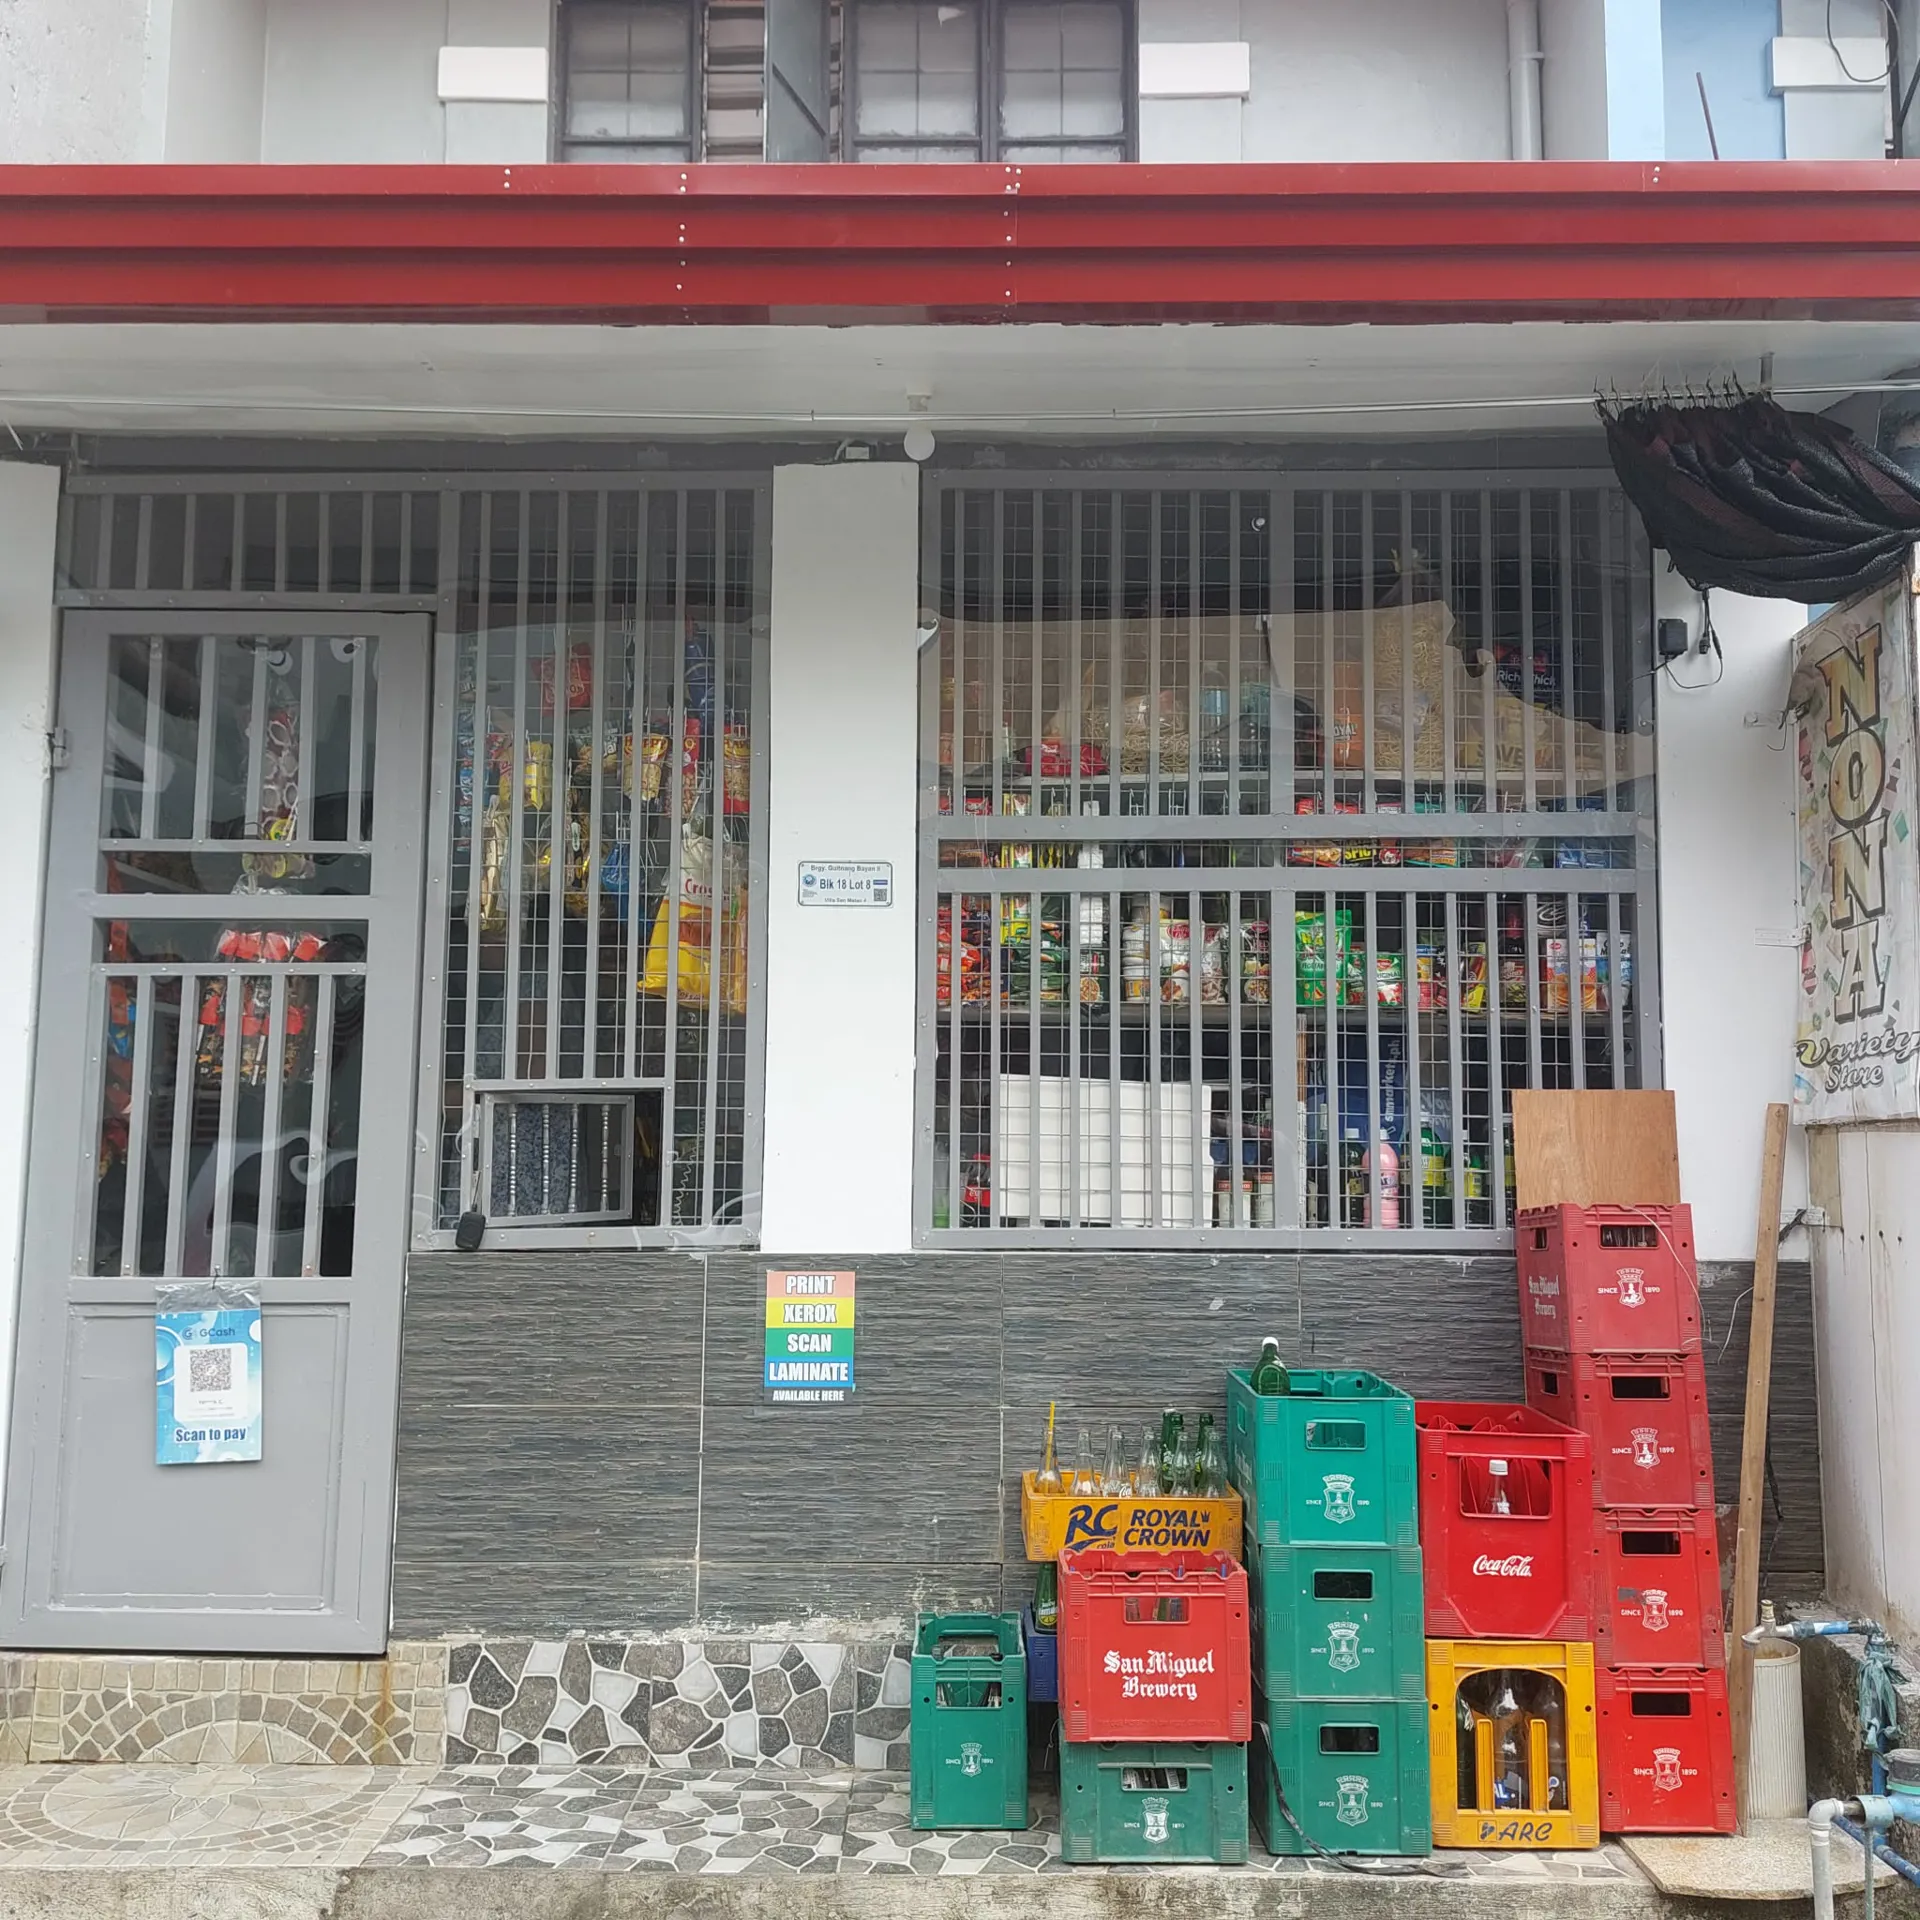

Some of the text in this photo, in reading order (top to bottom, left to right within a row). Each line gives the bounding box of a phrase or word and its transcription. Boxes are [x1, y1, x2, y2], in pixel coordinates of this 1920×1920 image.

[1497, 669, 1556, 686] Rich hick
[1815, 622, 1888, 1023] NONA
[819, 879, 871, 889] Blk 18 Lot 8
[1796, 1028, 1920, 1066] Variety
[1825, 1063, 1884, 1093] Store
[786, 1275, 836, 1294] PRINT
[1644, 1286, 1661, 1294] 1890
[783, 1304, 837, 1323] XEROX
[200, 1327, 236, 1337] GCash
[787, 1333, 832, 1352] SCAN
[769, 1362, 849, 1381] LAMINATE
[772, 1390, 844, 1401] AVAILABLE HERE
[175, 1428, 246, 1442] Scan to pay
[1064, 1504, 1118, 1546] RC
[1130, 1509, 1200, 1528] ROYAL
[1123, 1528, 1211, 1547] CROWN
[1473, 1554, 1533, 1577] Coca-Cola
[1620, 1609, 1684, 1617] SINCE 1890
[1103, 1649, 1215, 1677] San Miguel
[1122, 1676, 1198, 1700] Brewery
[1633, 1768, 1698, 1776] SINCE 1890
[1498, 1822, 1553, 1842] ARC
